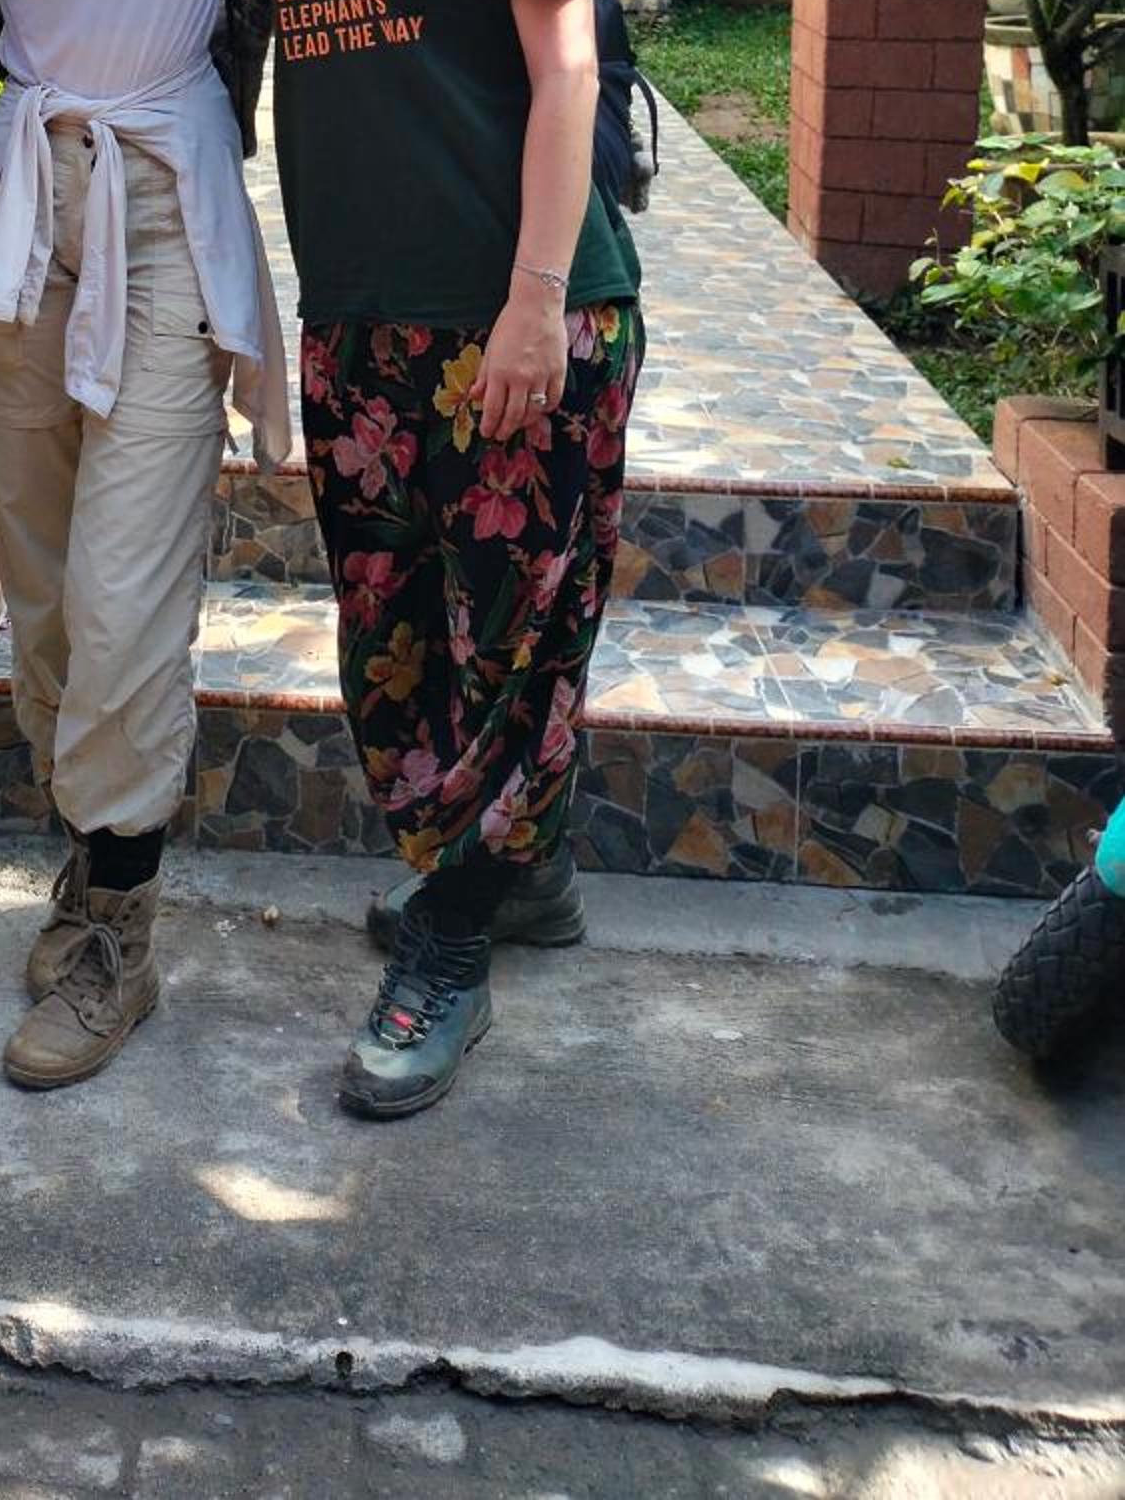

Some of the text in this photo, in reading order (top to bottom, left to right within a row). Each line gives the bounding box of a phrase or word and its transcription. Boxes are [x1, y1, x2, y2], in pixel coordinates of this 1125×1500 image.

[283, 16, 423, 61] LEAD THE WAY
